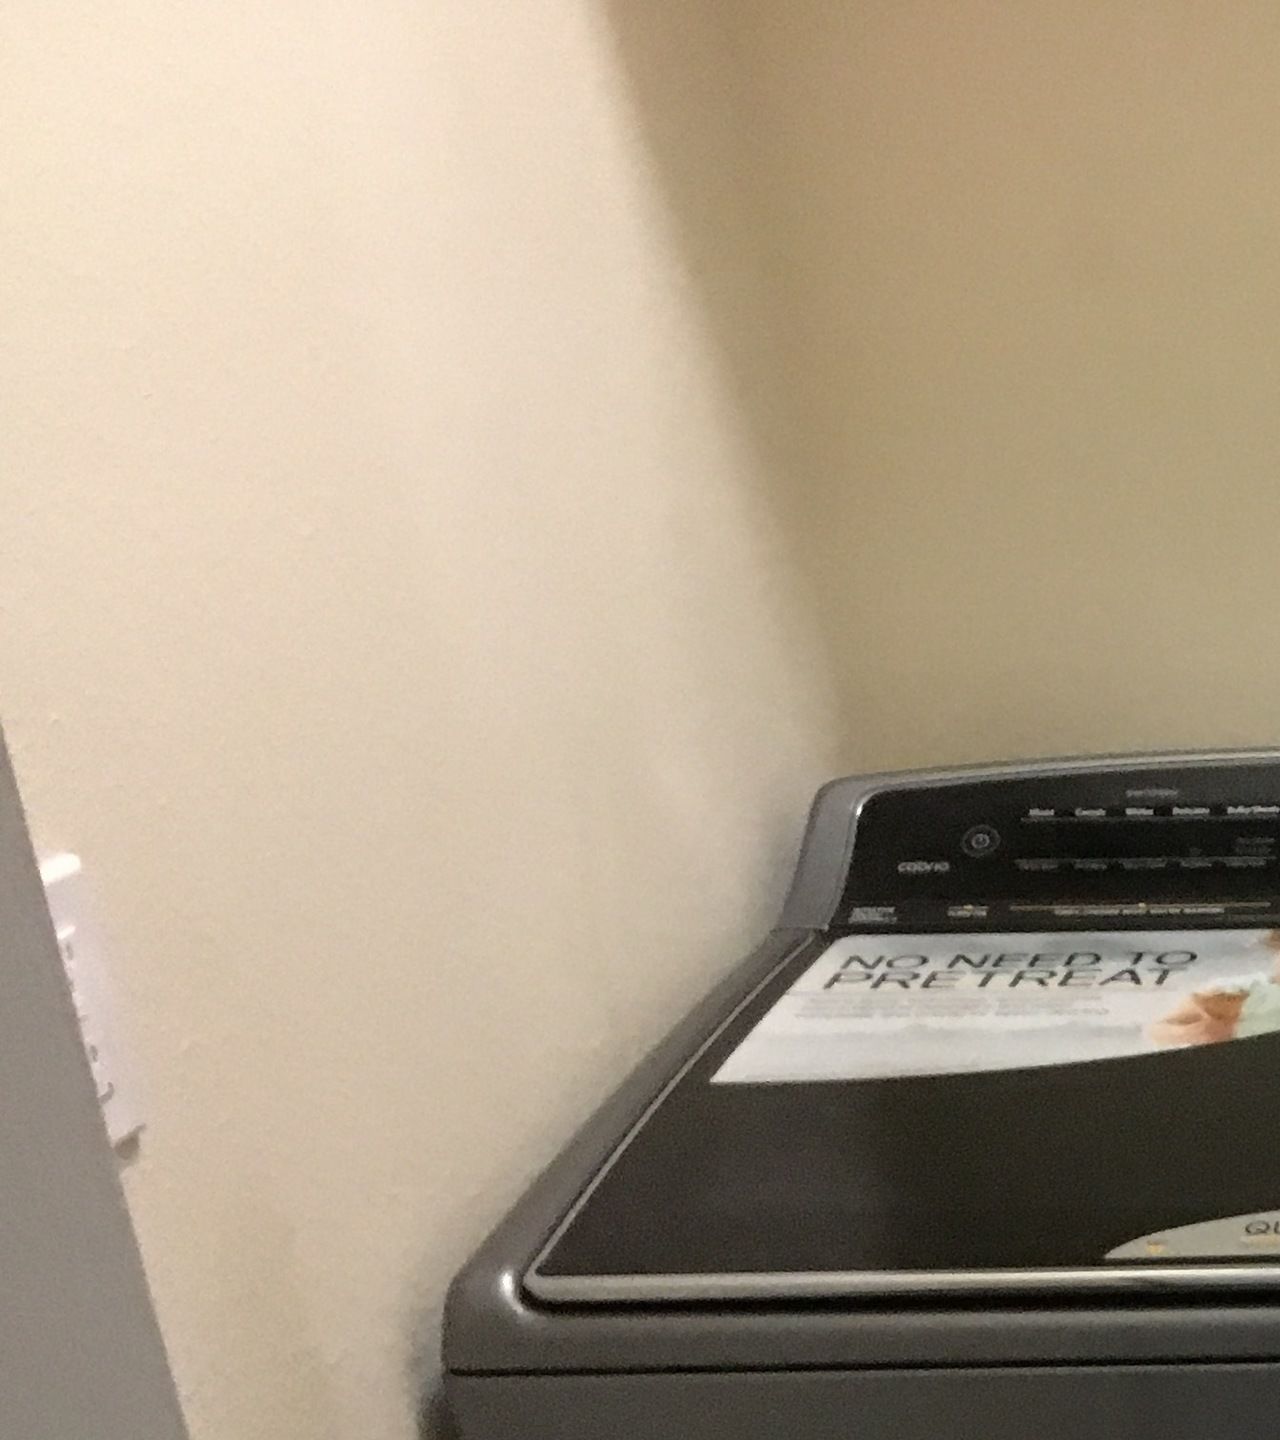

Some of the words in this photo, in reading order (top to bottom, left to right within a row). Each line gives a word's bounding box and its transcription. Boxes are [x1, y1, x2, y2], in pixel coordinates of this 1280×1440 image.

[840, 953, 930, 969] NO
[947, 952, 1102, 969] NEED
[1130, 950, 1199, 966] TO
[823, 967, 1185, 989] PRETREAT
